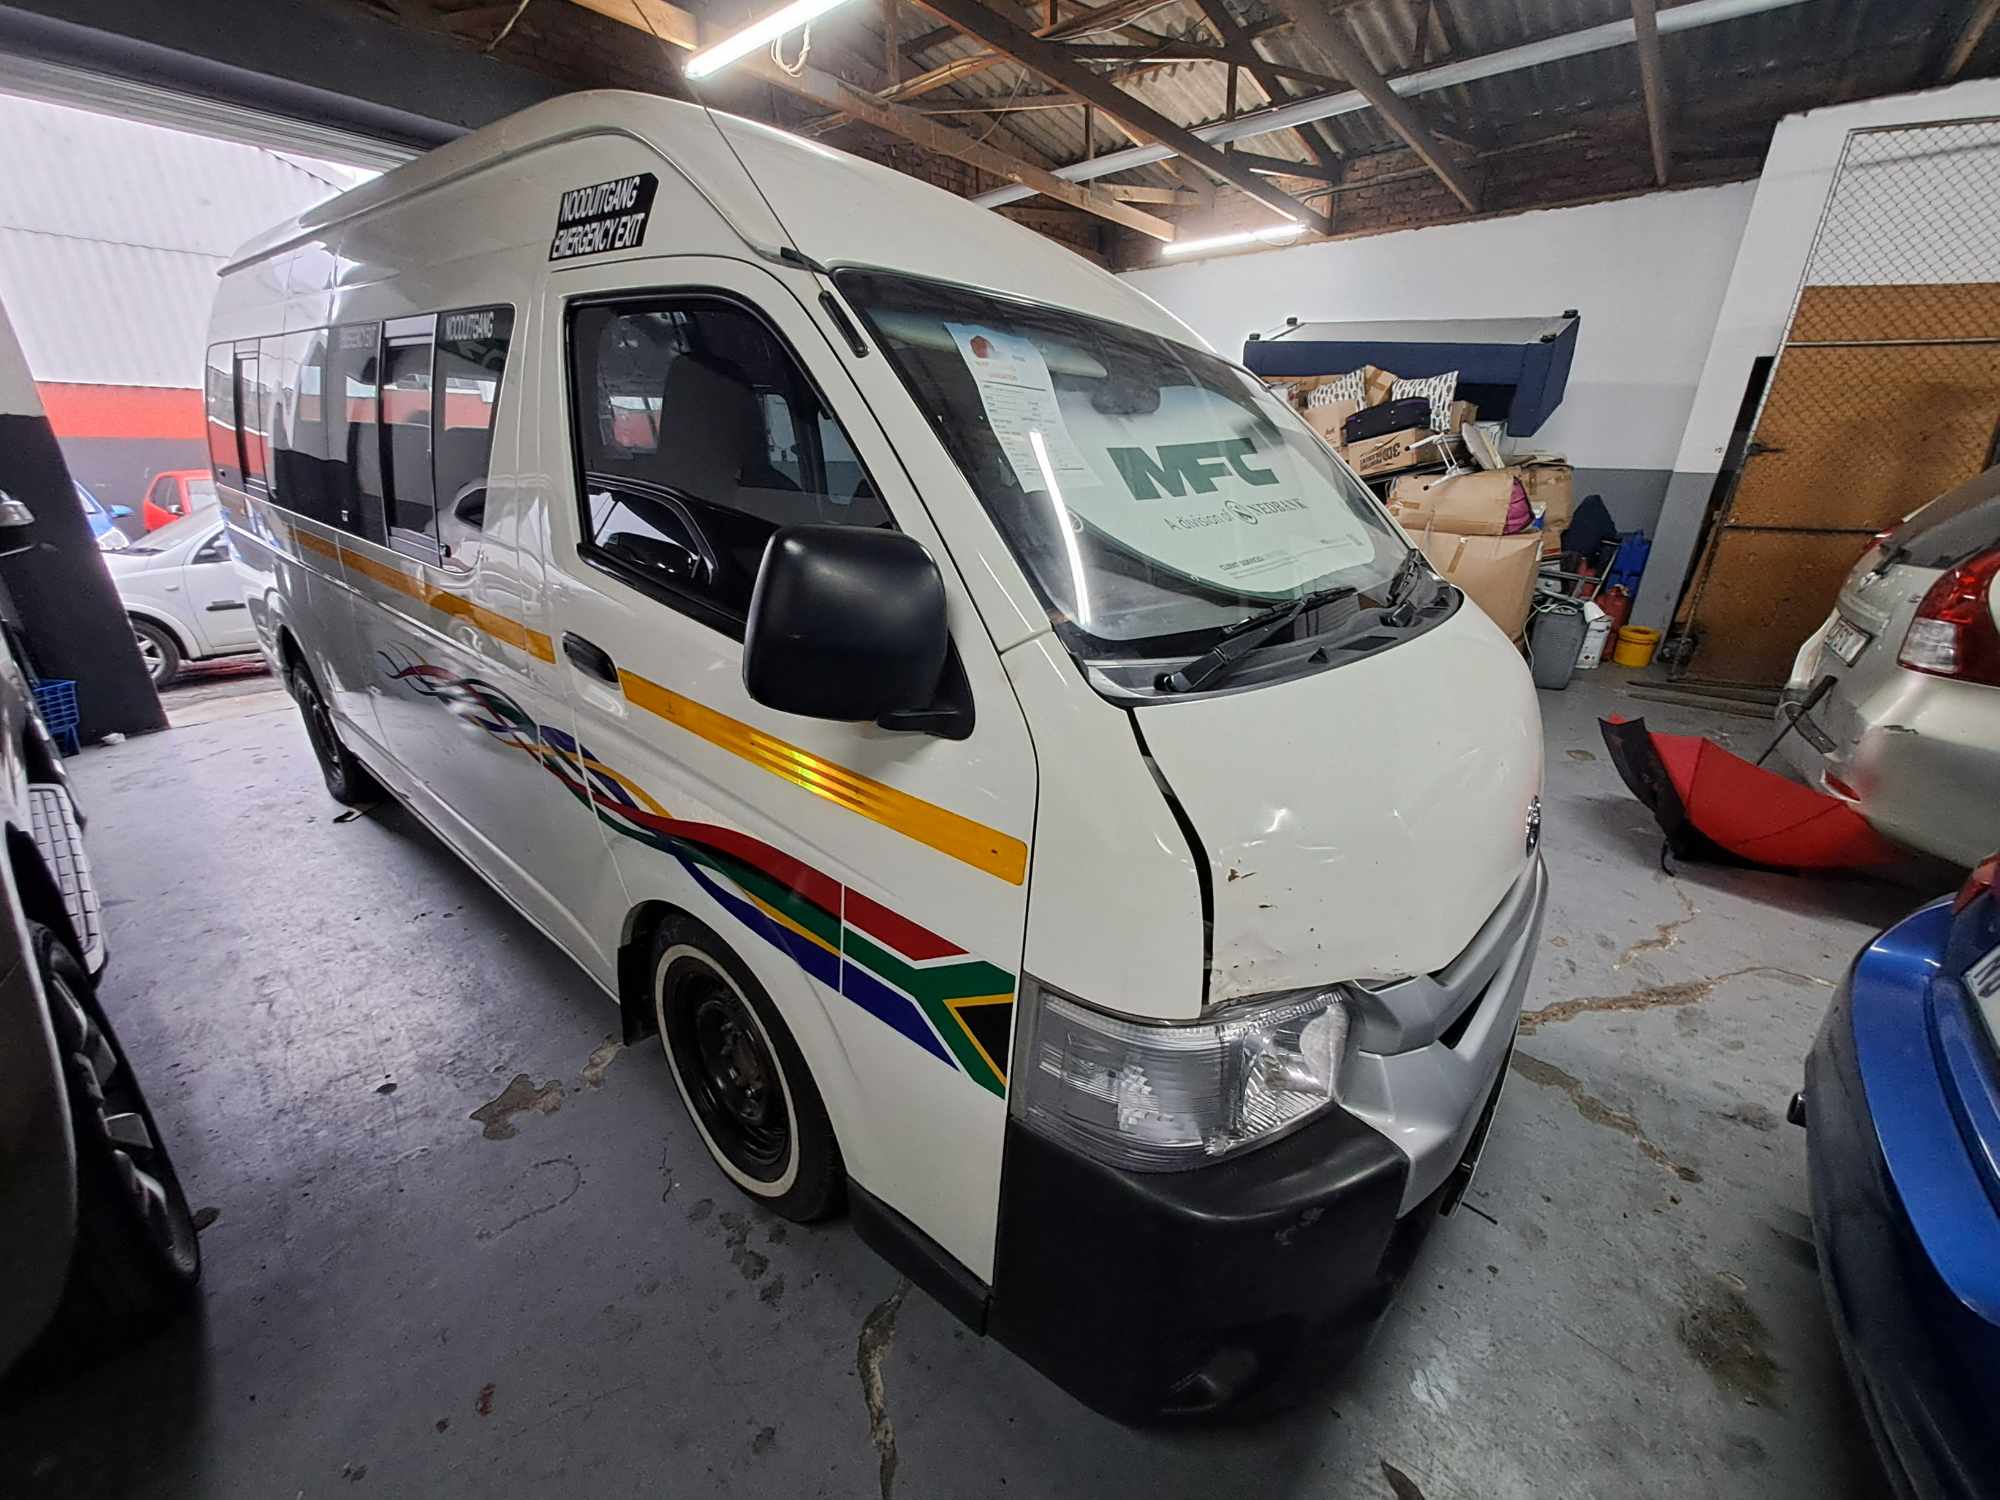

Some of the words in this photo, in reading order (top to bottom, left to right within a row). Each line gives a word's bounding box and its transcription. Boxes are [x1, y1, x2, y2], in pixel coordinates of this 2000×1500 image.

[561, 176, 641, 222] NOODUITGANG
[552, 217, 619, 259] EMERGENCY
[615, 213, 646, 248] EXIT
[1106, 437, 1280, 501] MFC
[1247, 498, 1309, 516] NEDBANK
